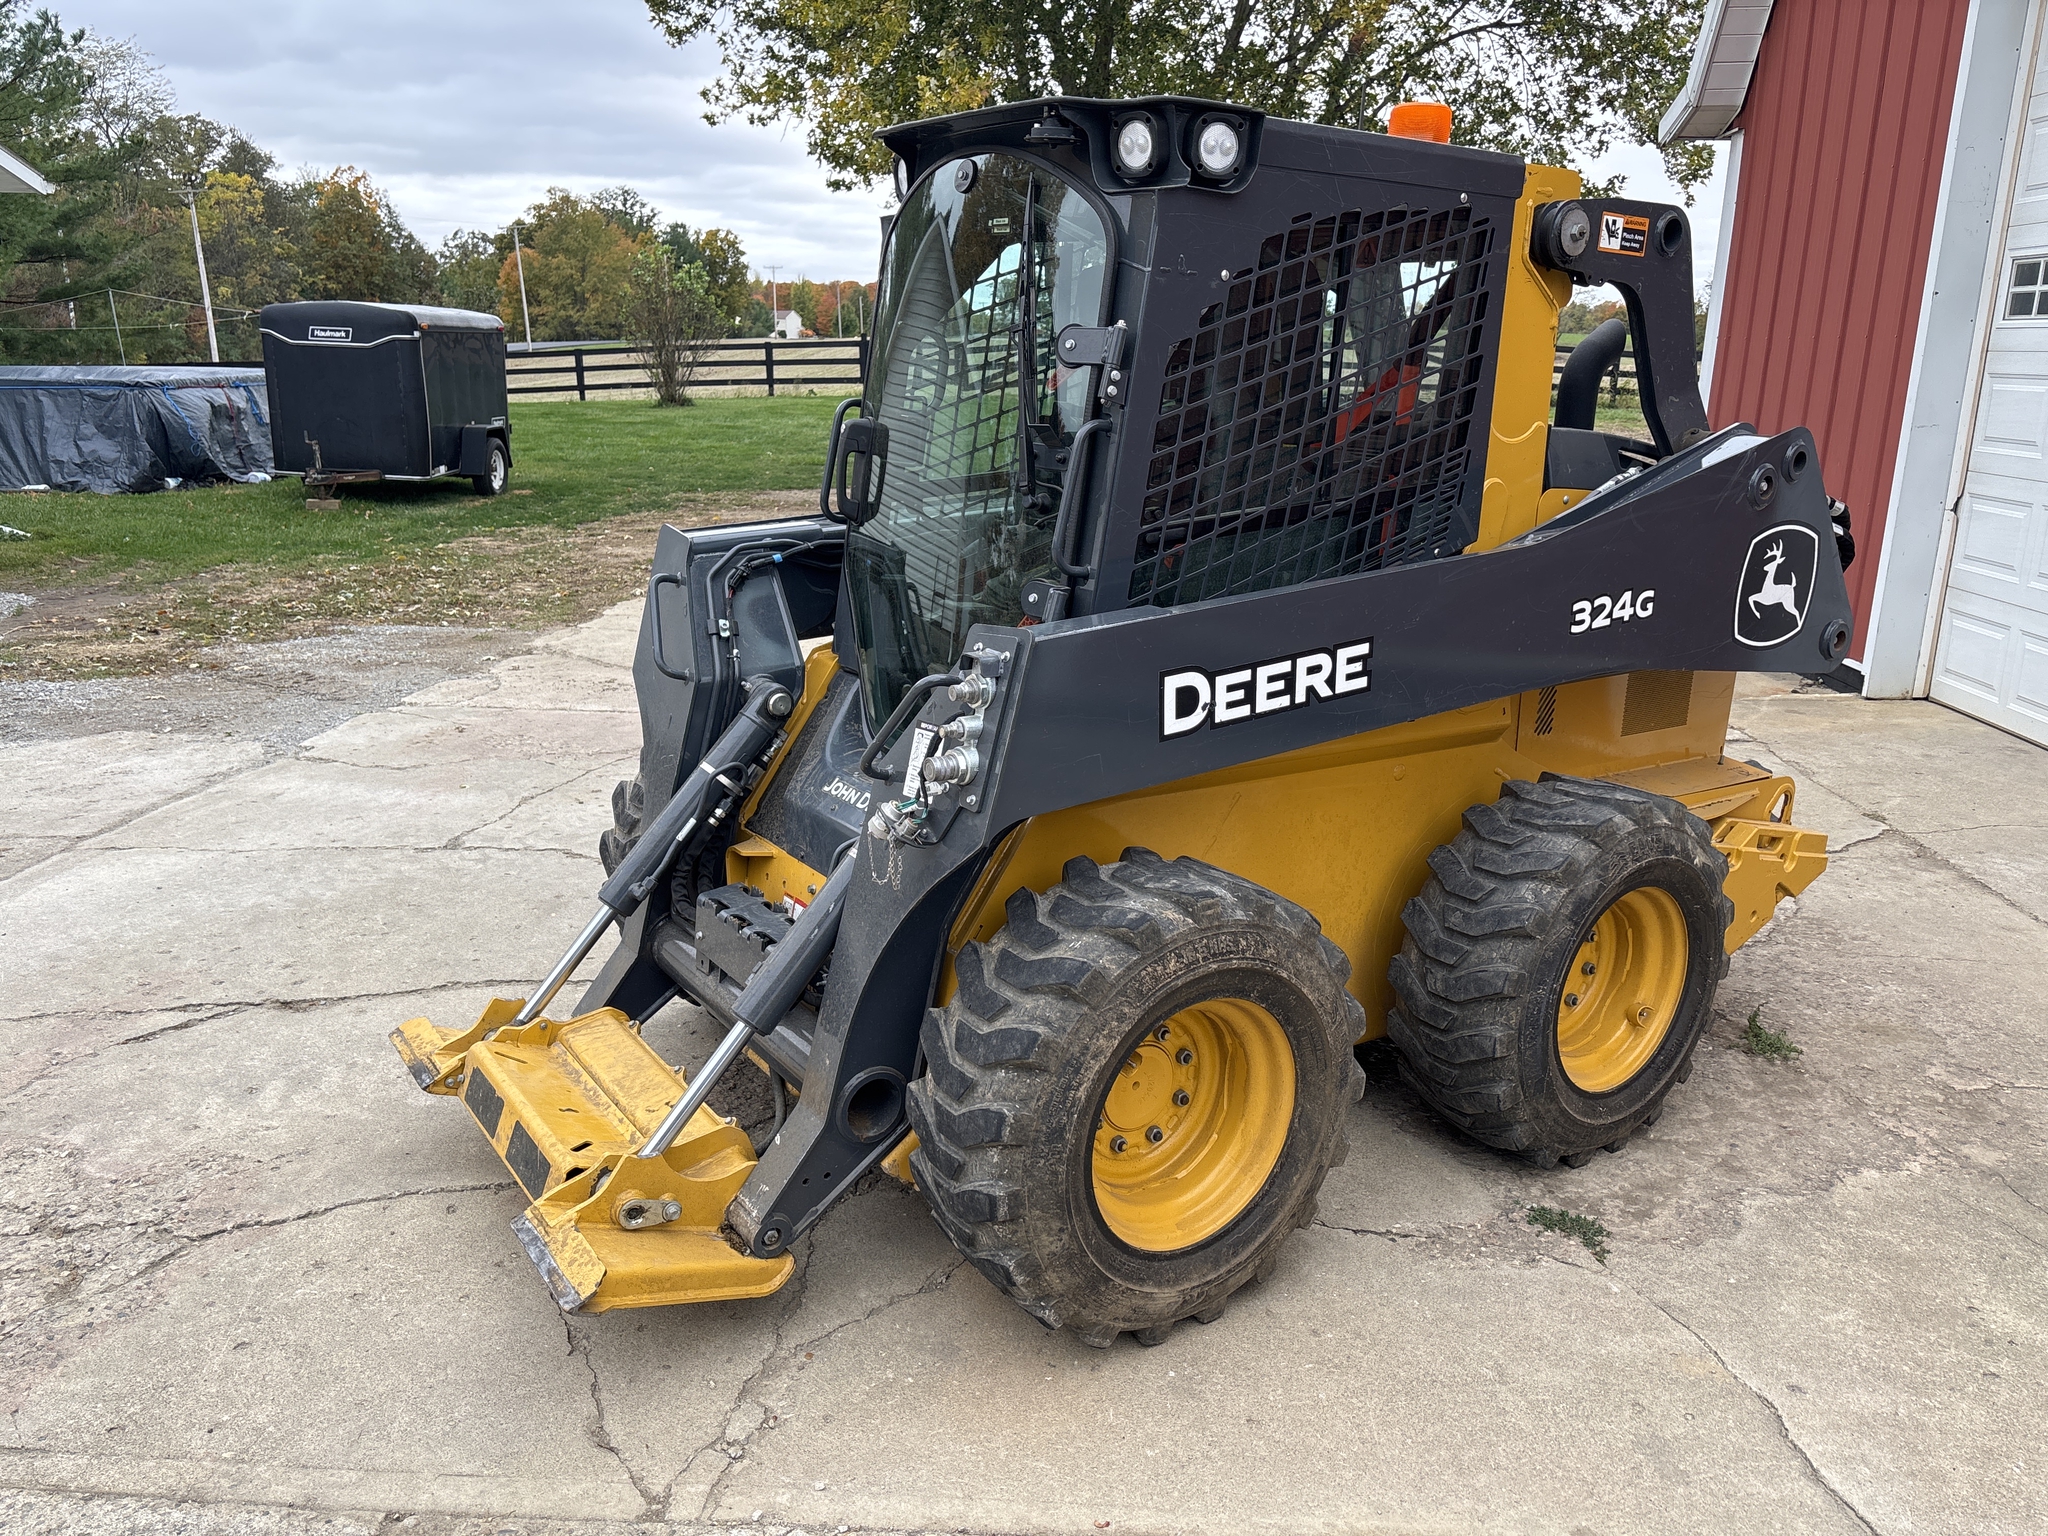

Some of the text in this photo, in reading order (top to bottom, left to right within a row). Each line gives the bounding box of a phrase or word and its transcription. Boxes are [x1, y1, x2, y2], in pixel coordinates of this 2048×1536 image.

[1630, 241, 1640, 249] Away
[314, 329, 346, 338] Haulmark
[1570, 589, 1655, 634] 324G
[1163, 641, 1371, 736] DEERE
[823, 777, 871, 812] JOHN D
